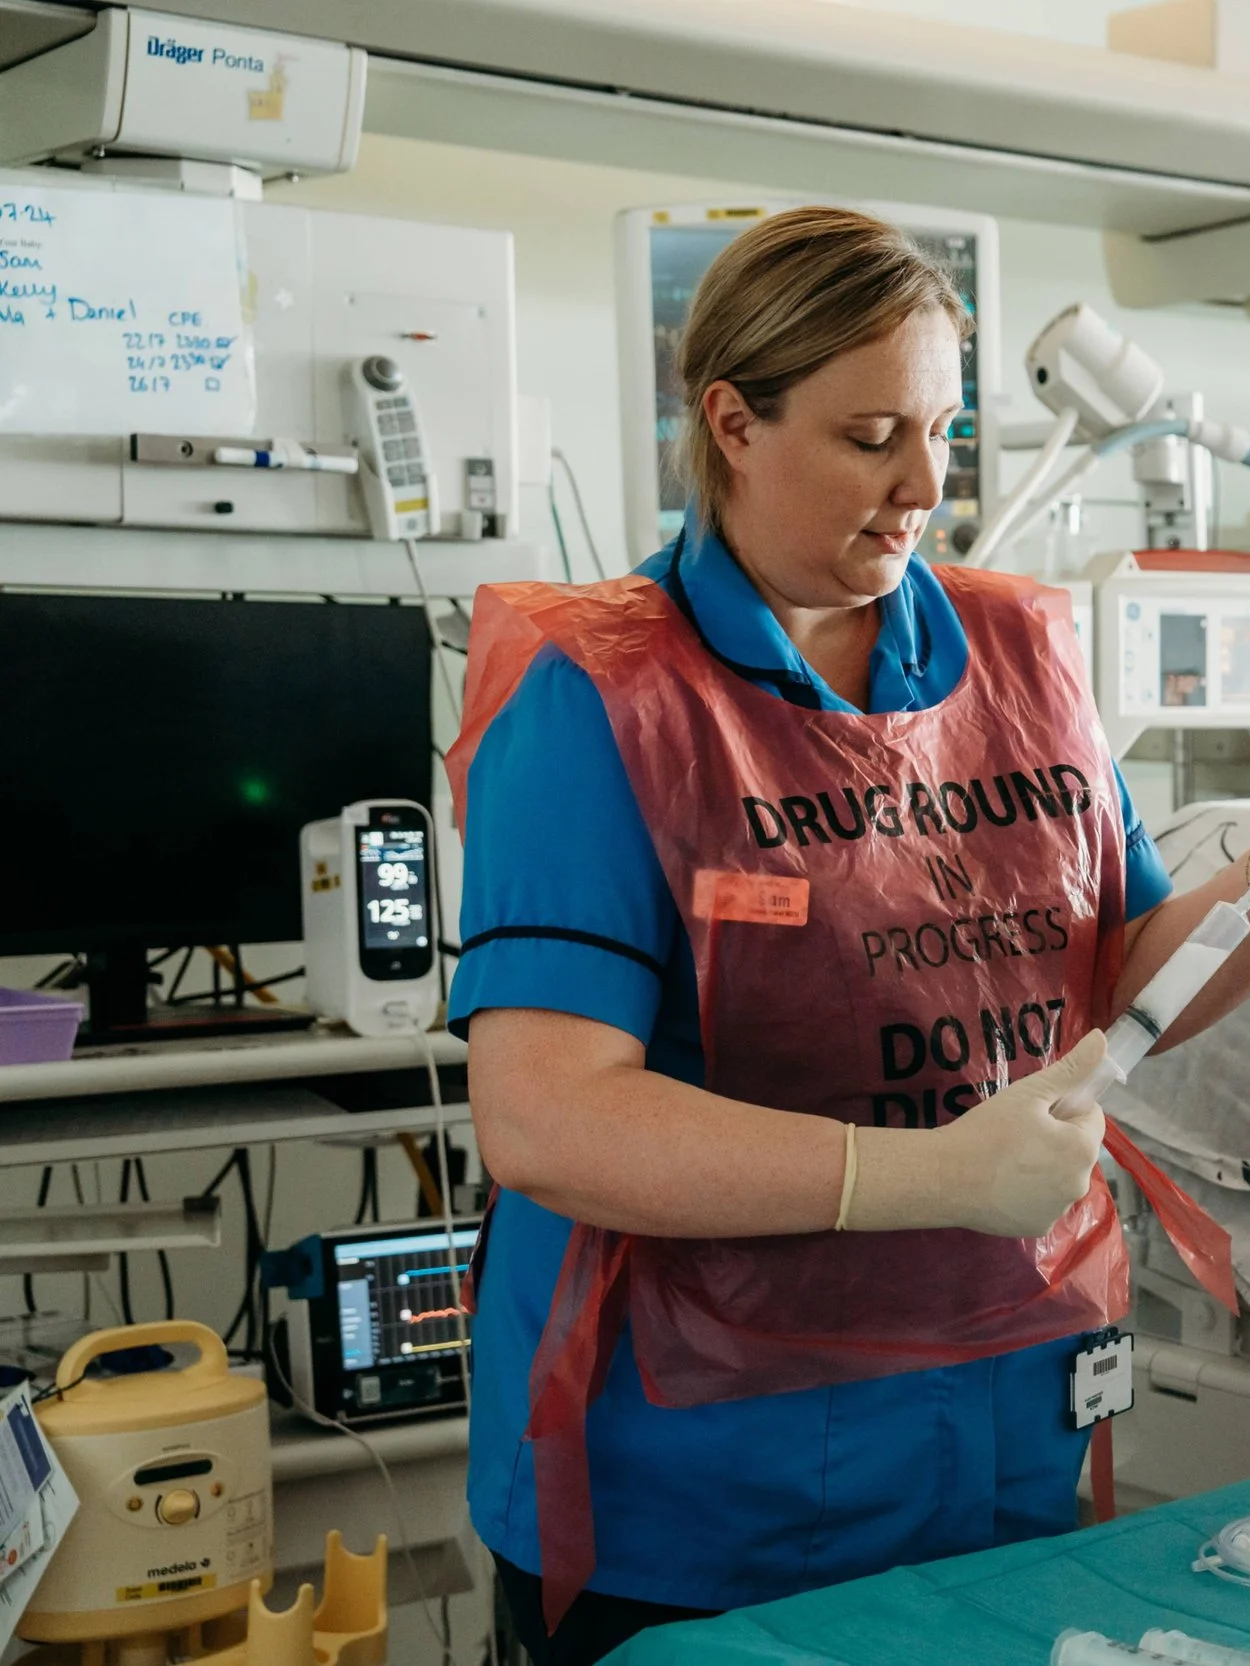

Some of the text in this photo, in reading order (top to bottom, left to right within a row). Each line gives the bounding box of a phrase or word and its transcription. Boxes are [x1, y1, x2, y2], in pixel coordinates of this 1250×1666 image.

[147, 36, 264, 72] Dräger Ponta
[742, 763, 1092, 849] DRUG ROUND
[377, 862, 408, 887] 99
[924, 853, 976, 901] IN
[367, 898, 410, 923] 125
[861, 907, 1069, 977] PROGRESS
[880, 998, 1066, 1081] DO NOT
